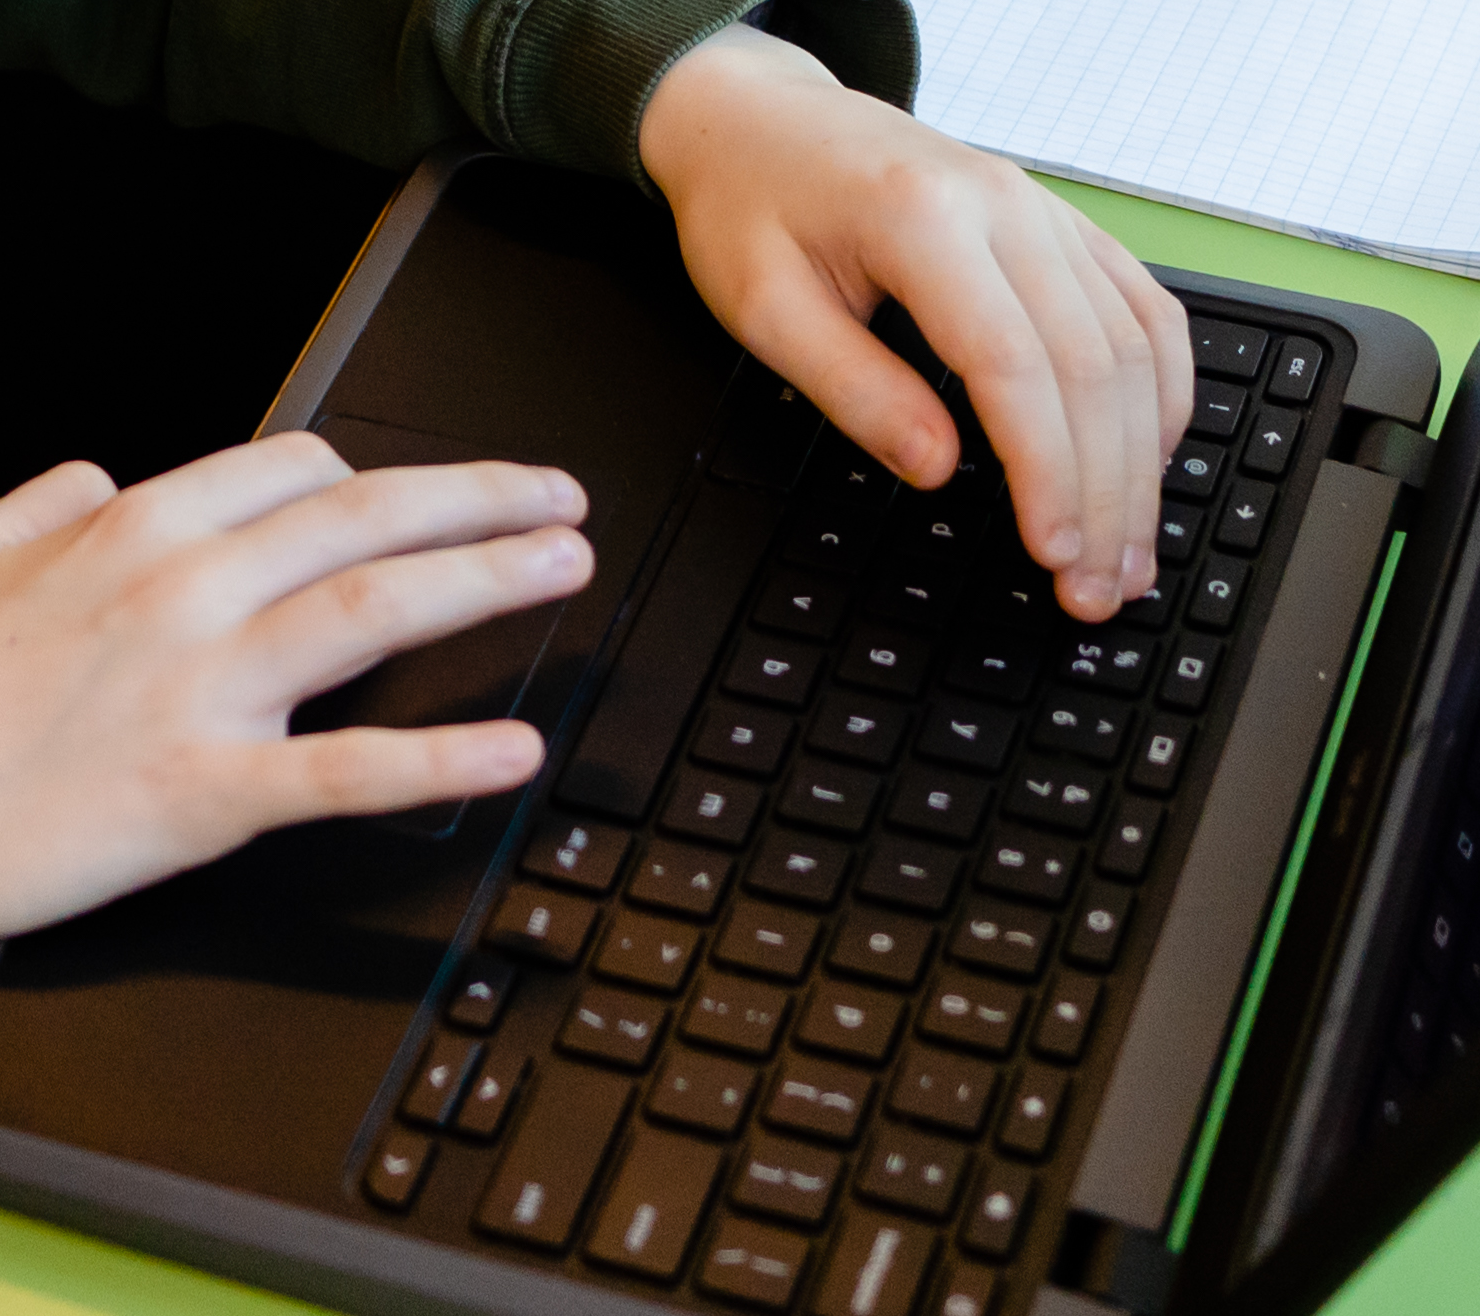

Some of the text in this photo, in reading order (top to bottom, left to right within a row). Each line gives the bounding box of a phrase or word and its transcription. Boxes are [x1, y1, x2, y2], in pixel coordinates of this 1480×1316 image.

[1288, 356, 1305, 377] esc
[1184, 458, 1208, 476] @
[849, 471, 865, 484] x
[932, 523, 953, 536] d
[1163, 522, 1185, 538] #
[821, 533, 839, 544] c
[905, 586, 929, 600] f
[793, 597, 811, 610] v
[869, 649, 896, 666] g
[1078, 644, 1102, 658] 5
[763, 659, 790, 676] b
[847, 716, 875, 733] h
[1052, 710, 1077, 726] 6
[731, 726, 753, 744] n
[951, 721, 978, 739] y
[812, 785, 843, 801] j
[1027, 780, 1052, 796] 7
[699, 792, 725, 817] m
[998, 848, 1025, 867] 8
[970, 921, 998, 939] 9
[869, 933, 893, 952] o
[941, 994, 969, 1015] 0
